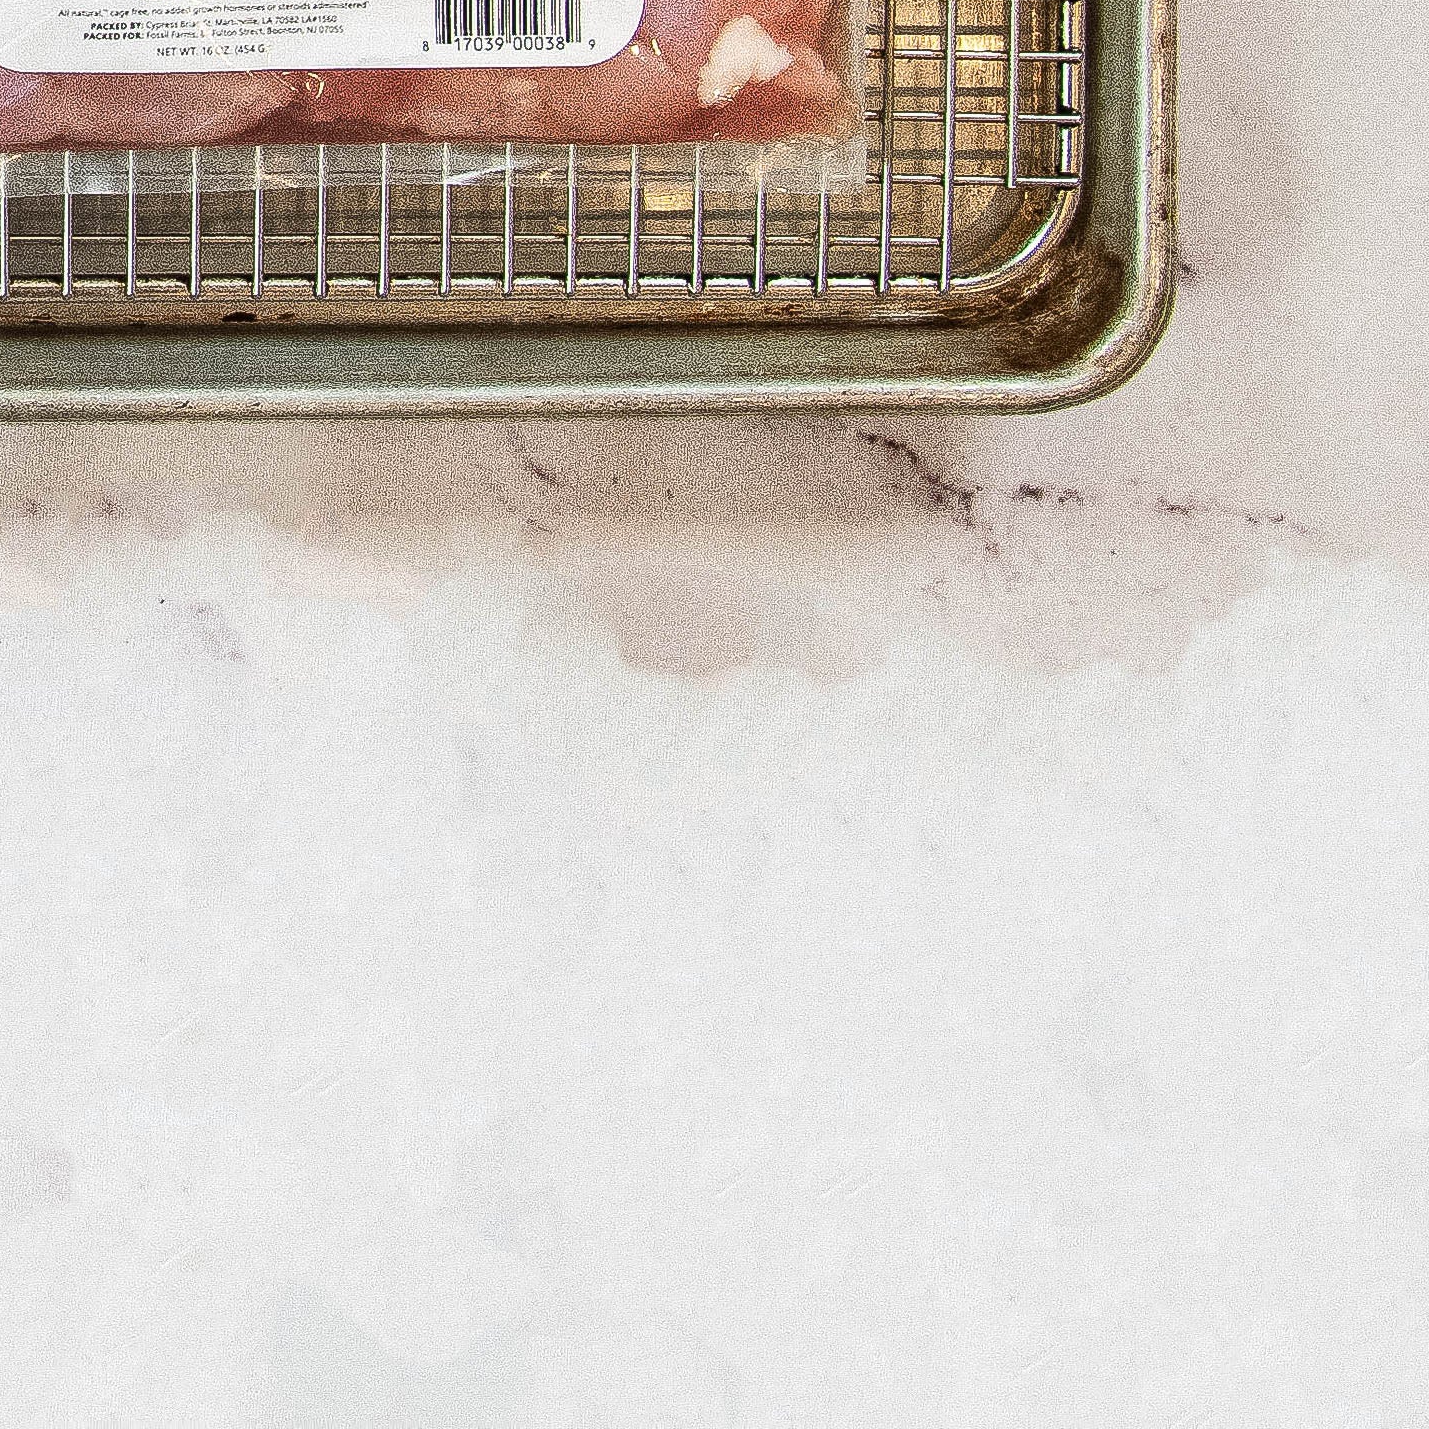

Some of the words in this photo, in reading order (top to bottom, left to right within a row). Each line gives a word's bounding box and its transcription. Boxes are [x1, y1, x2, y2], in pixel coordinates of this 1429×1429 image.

[110, 10, 129, 18] cage
[262, 16, 272, 24] LA
[84, 32, 120, 40] PACKED
[423, 41, 429, 51] 8
[455, 37, 504, 50] 17039
[513, 37, 565, 50] 00038
[589, 39, 595, 50] 9
[157, 47, 177, 56] NET
[180, 47, 199, 56] WT.
[203, 47, 213, 55] 16
